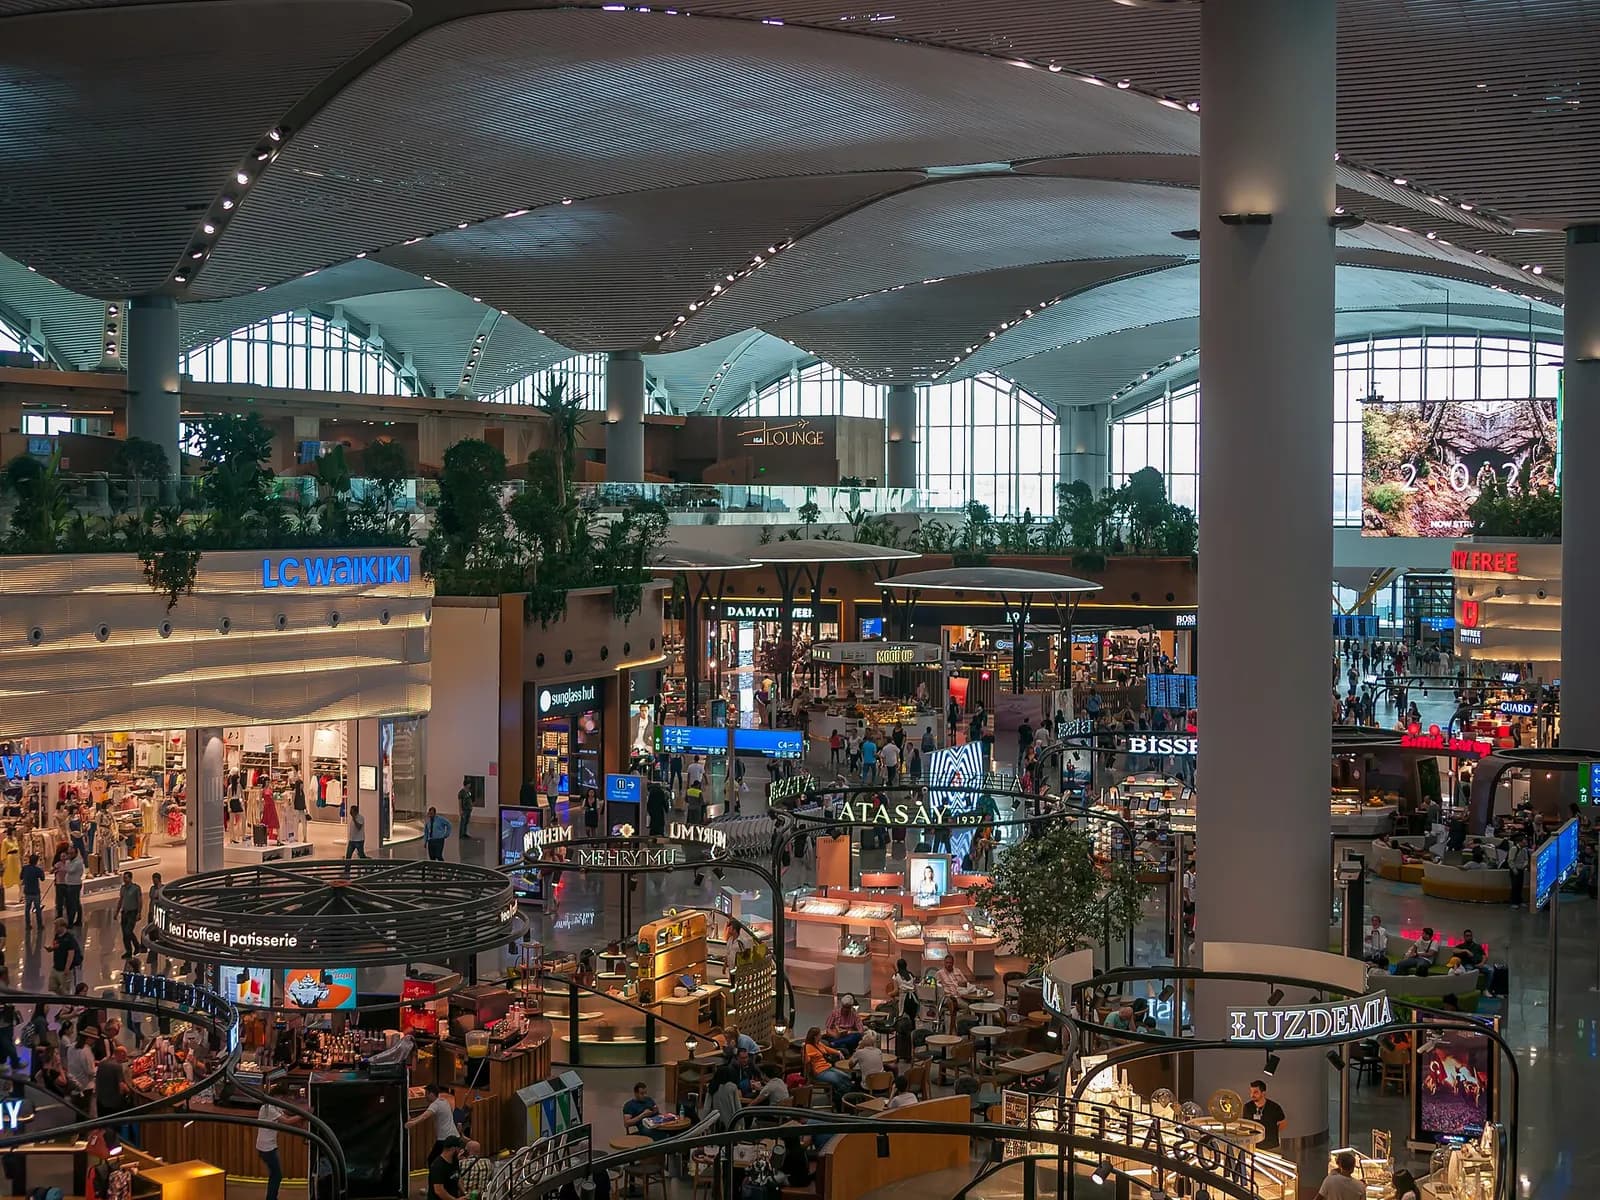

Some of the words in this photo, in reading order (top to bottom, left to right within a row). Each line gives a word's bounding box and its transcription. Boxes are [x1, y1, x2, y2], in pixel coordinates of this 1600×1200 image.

[766, 431, 824, 446] LOUNGE
[1471, 552, 1519, 573] FREE
[262, 557, 300, 588] LC
[727, 606, 775, 617] DAMAT
[876, 650, 901, 663] MOOD
[902, 650, 914, 663] UP
[552, 688, 582, 707] sunglass
[582, 685, 595, 699] hut
[1500, 702, 1532, 714] GUARD
[778, 741, 788, 749] C4
[838, 802, 950, 824] ATASAY
[956, 815, 983, 825] 1937
[578, 849, 642, 866] MEHRY
[645, 849, 677, 866] MU
[187, 926, 221, 943] coffee
[229, 932, 298, 948] patisserie
[1230, 995, 1392, 1041] LUZDEMIA
